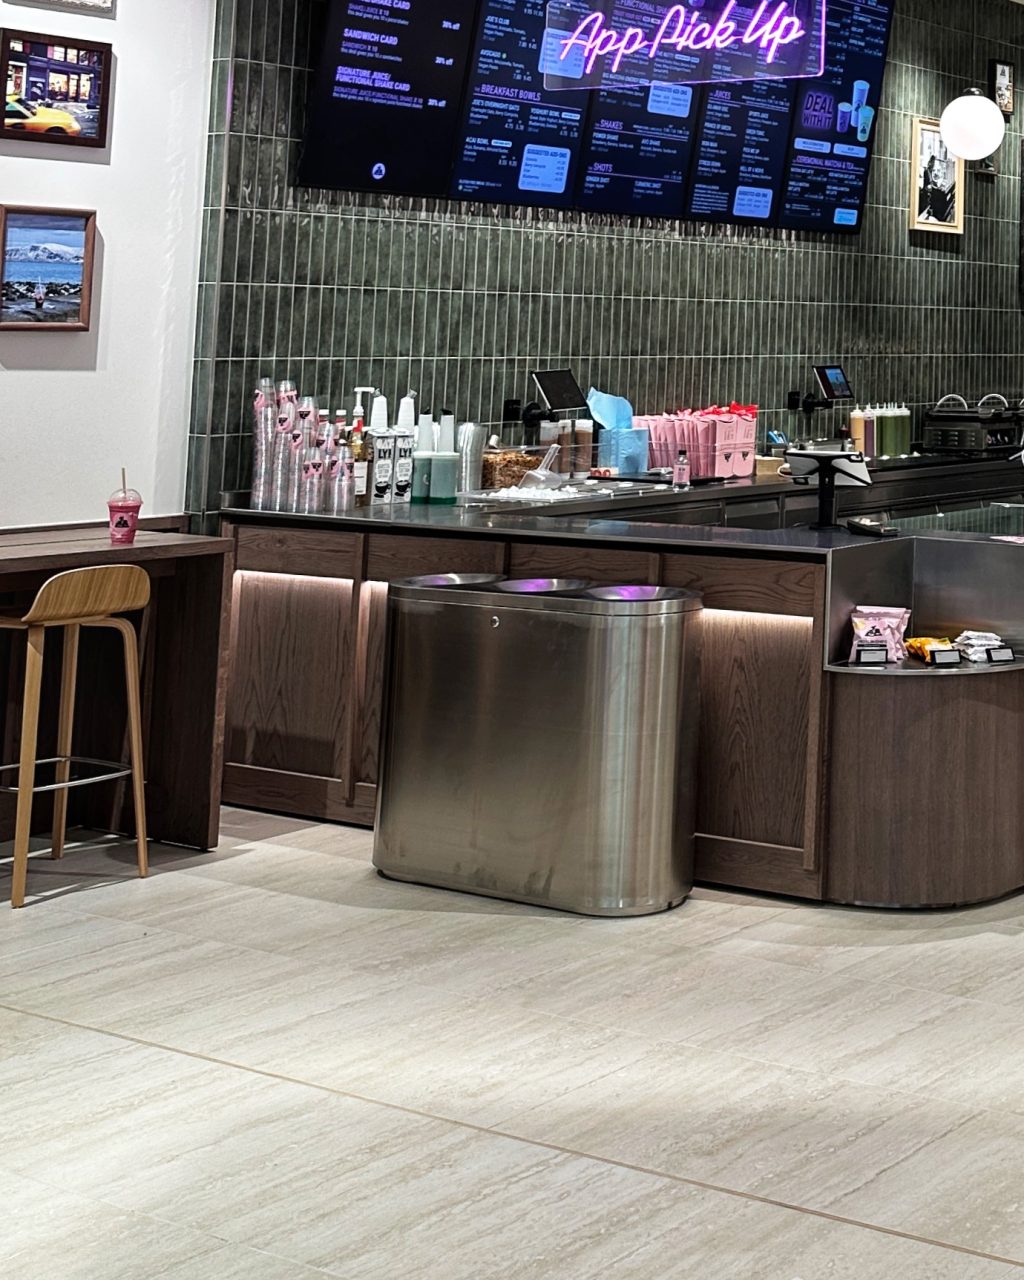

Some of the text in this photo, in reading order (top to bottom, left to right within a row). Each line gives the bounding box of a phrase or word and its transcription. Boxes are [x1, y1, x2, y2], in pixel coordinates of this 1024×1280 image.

[392, 0, 411, 10] CARD
[344, 28, 398, 45] SANDWICH CARD
[560, 11, 649, 74] App
[743, 0, 806, 63] Up
[394, 82, 411, 92] CARD
[481, 84, 541, 101] BREAKFAST BOWLS
[803, 94, 833, 128] DEAL WITH IT
[600, 119, 623, 130] SHAKES
[593, 162, 613, 173] SHOTS
